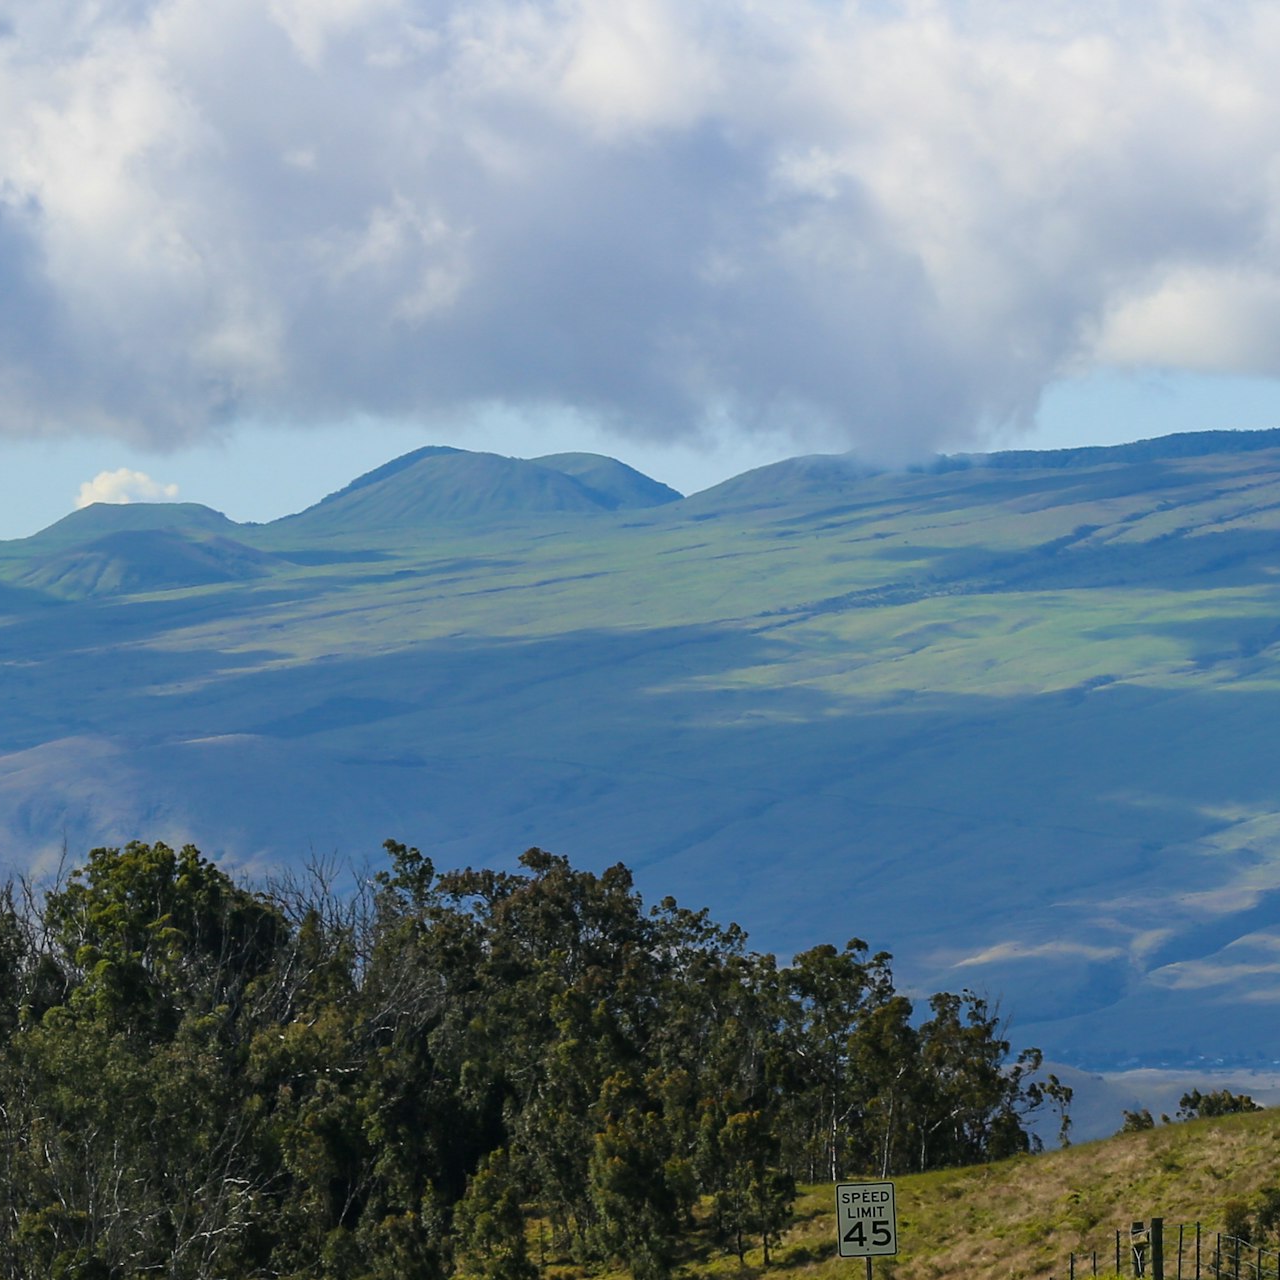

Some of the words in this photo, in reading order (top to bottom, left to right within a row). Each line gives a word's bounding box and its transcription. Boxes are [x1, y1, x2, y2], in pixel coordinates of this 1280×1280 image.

[842, 1191, 890, 1204] SPEED
[847, 1206, 885, 1219] LIMIT
[843, 1220, 892, 1247] 45
